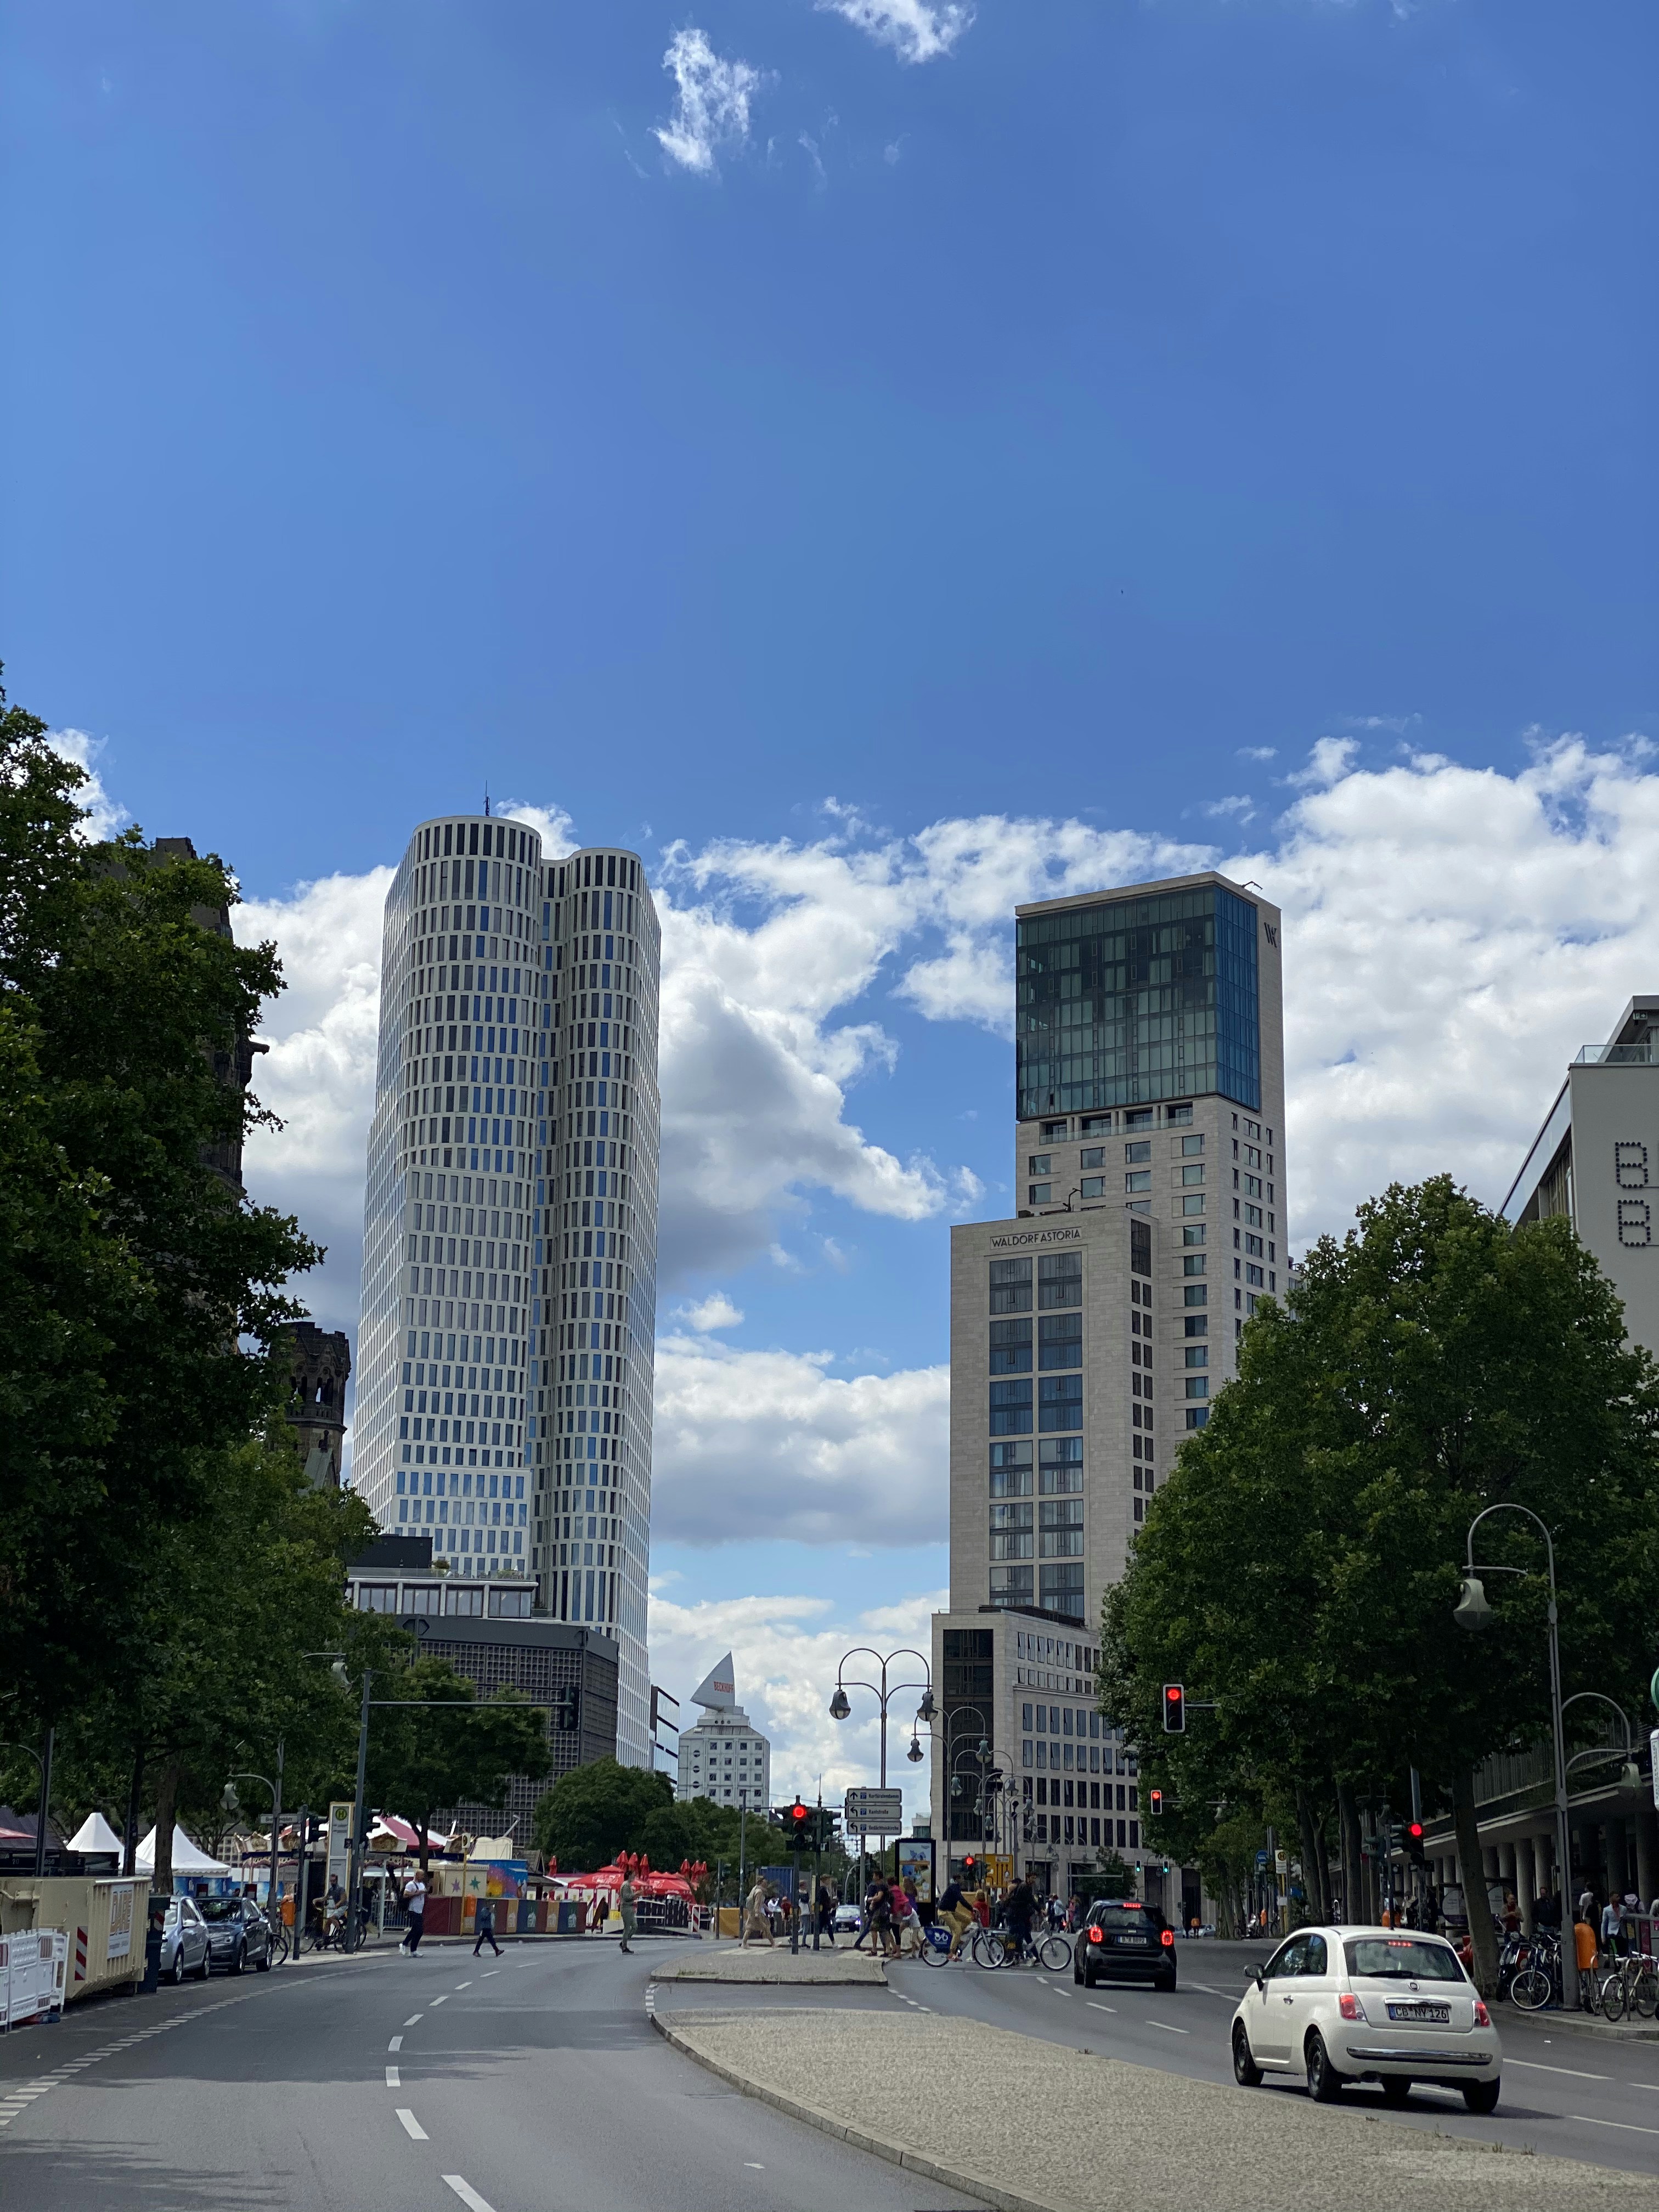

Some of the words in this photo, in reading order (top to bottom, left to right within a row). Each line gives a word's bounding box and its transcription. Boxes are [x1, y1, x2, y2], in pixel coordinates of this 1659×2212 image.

[992, 1233, 1039, 1247] WALDORF
[1040, 1229, 1080, 1242] ASTORIA
[714, 1681, 733, 1694] BECKHOFF
[1396, 2007, 1408, 2017] CB
[1429, 2010, 1447, 2019] 126
